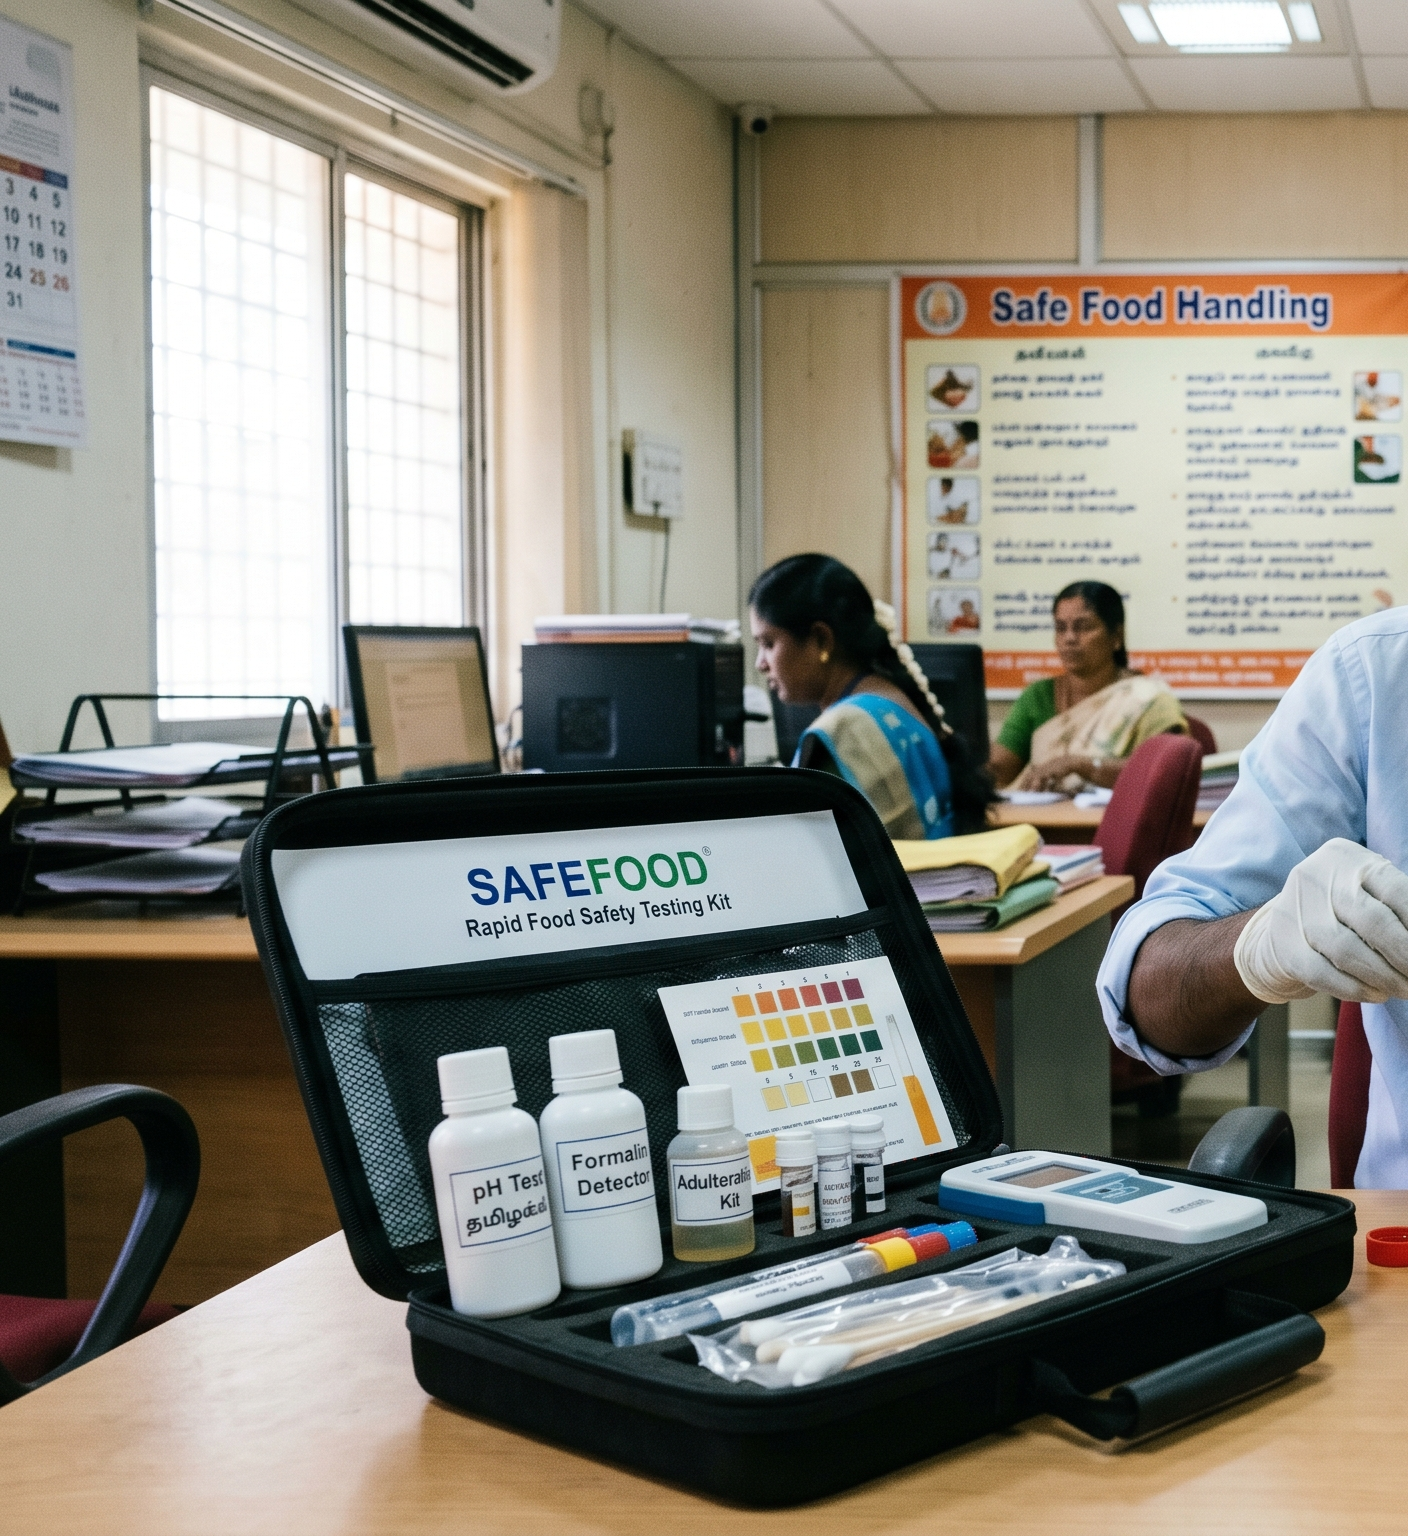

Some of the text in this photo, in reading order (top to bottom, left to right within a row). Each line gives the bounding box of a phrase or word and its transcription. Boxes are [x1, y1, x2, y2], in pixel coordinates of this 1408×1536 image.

[6, 177, 14, 196] 3
[29, 185, 38, 201] 4
[4, 205, 66, 237] 10 11 12
[5, 234, 20, 252] 17
[29, 240, 44, 259] 18
[5, 261, 22, 281] 24
[7, 290, 22, 309] 31
[993, 288, 1329, 328] Safe Food Handling
[465, 893, 732, 939] Rapid Food Safety Testing Kit
[572, 1143, 648, 1171] Formalin
[473, 1178, 502, 1204] pH
[578, 1171, 650, 1196] Detector
[720, 1193, 740, 1210] Kit
